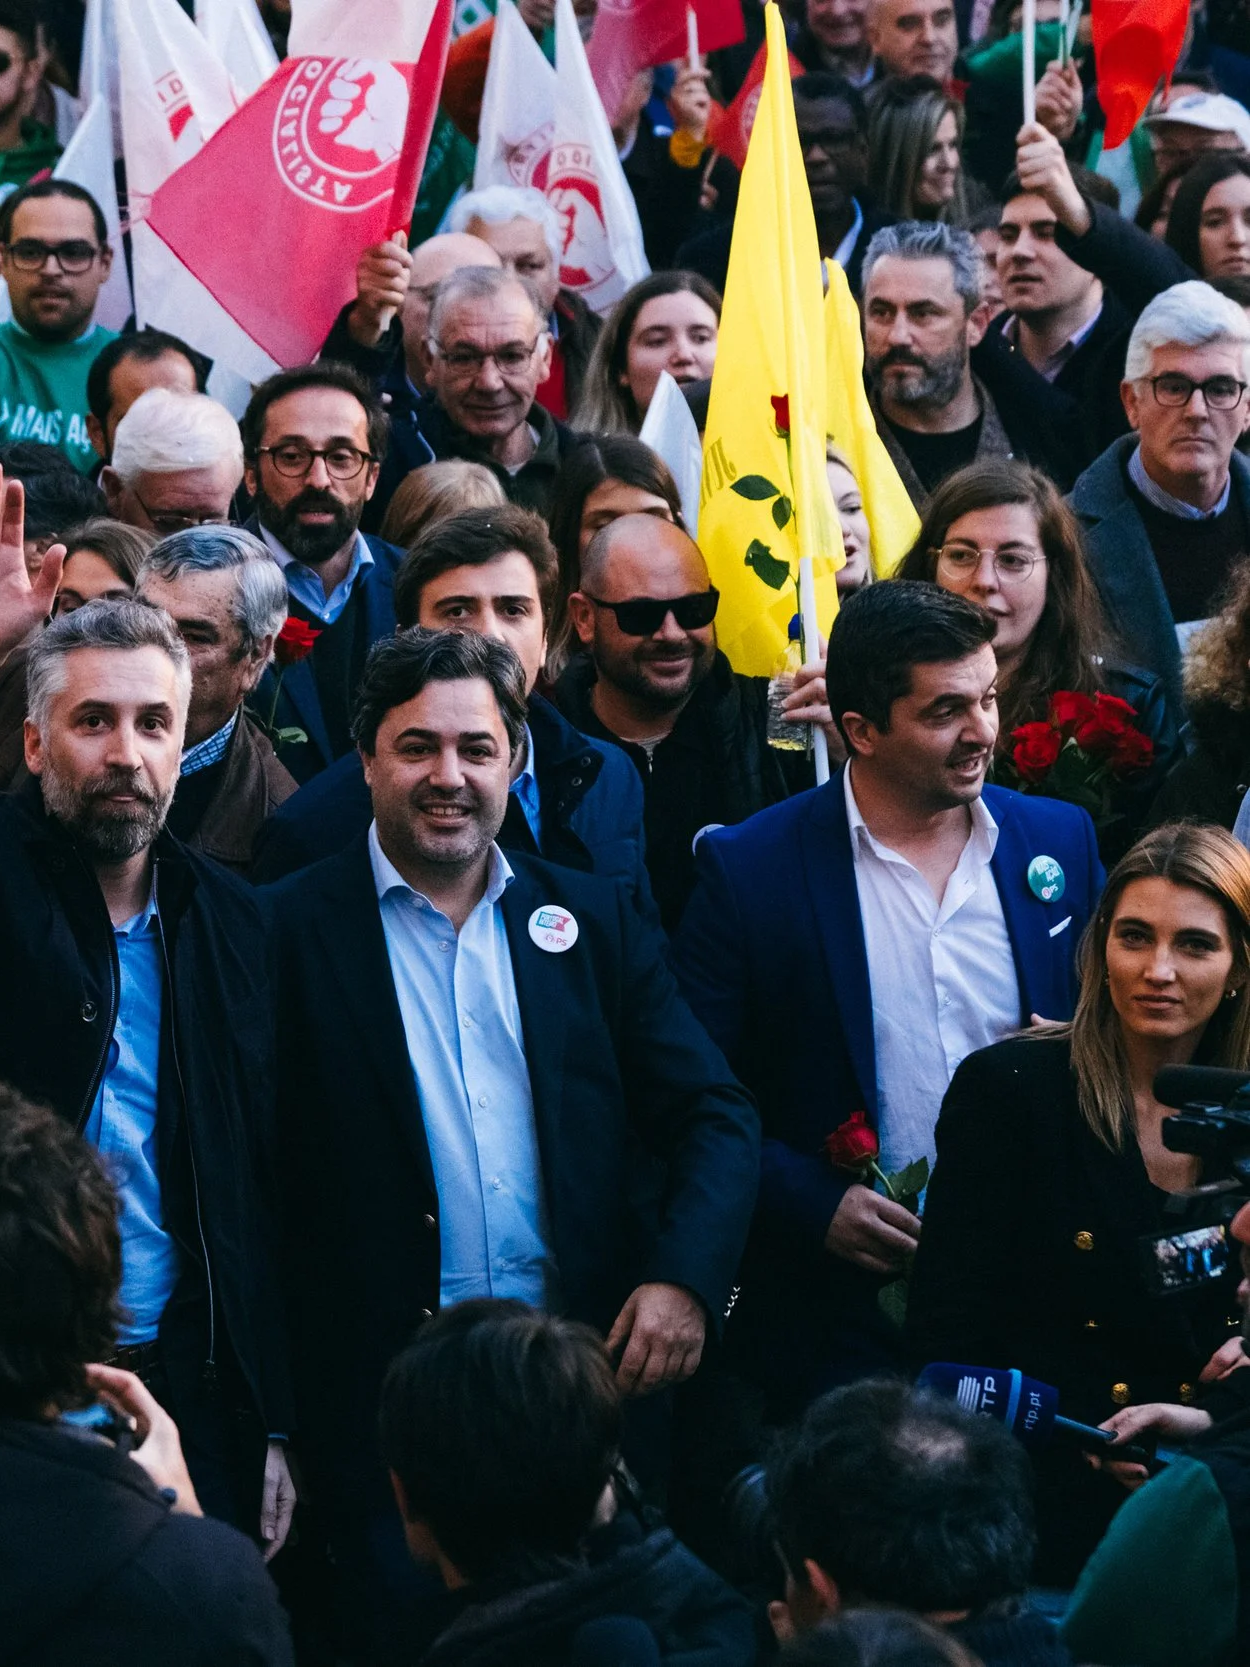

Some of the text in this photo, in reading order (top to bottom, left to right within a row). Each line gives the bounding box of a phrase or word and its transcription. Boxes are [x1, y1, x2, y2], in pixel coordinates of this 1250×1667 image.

[10, 403, 63, 444] MAIS
[556, 937, 567, 947] PS
[1025, 1392, 1042, 1430] rtp.pt
